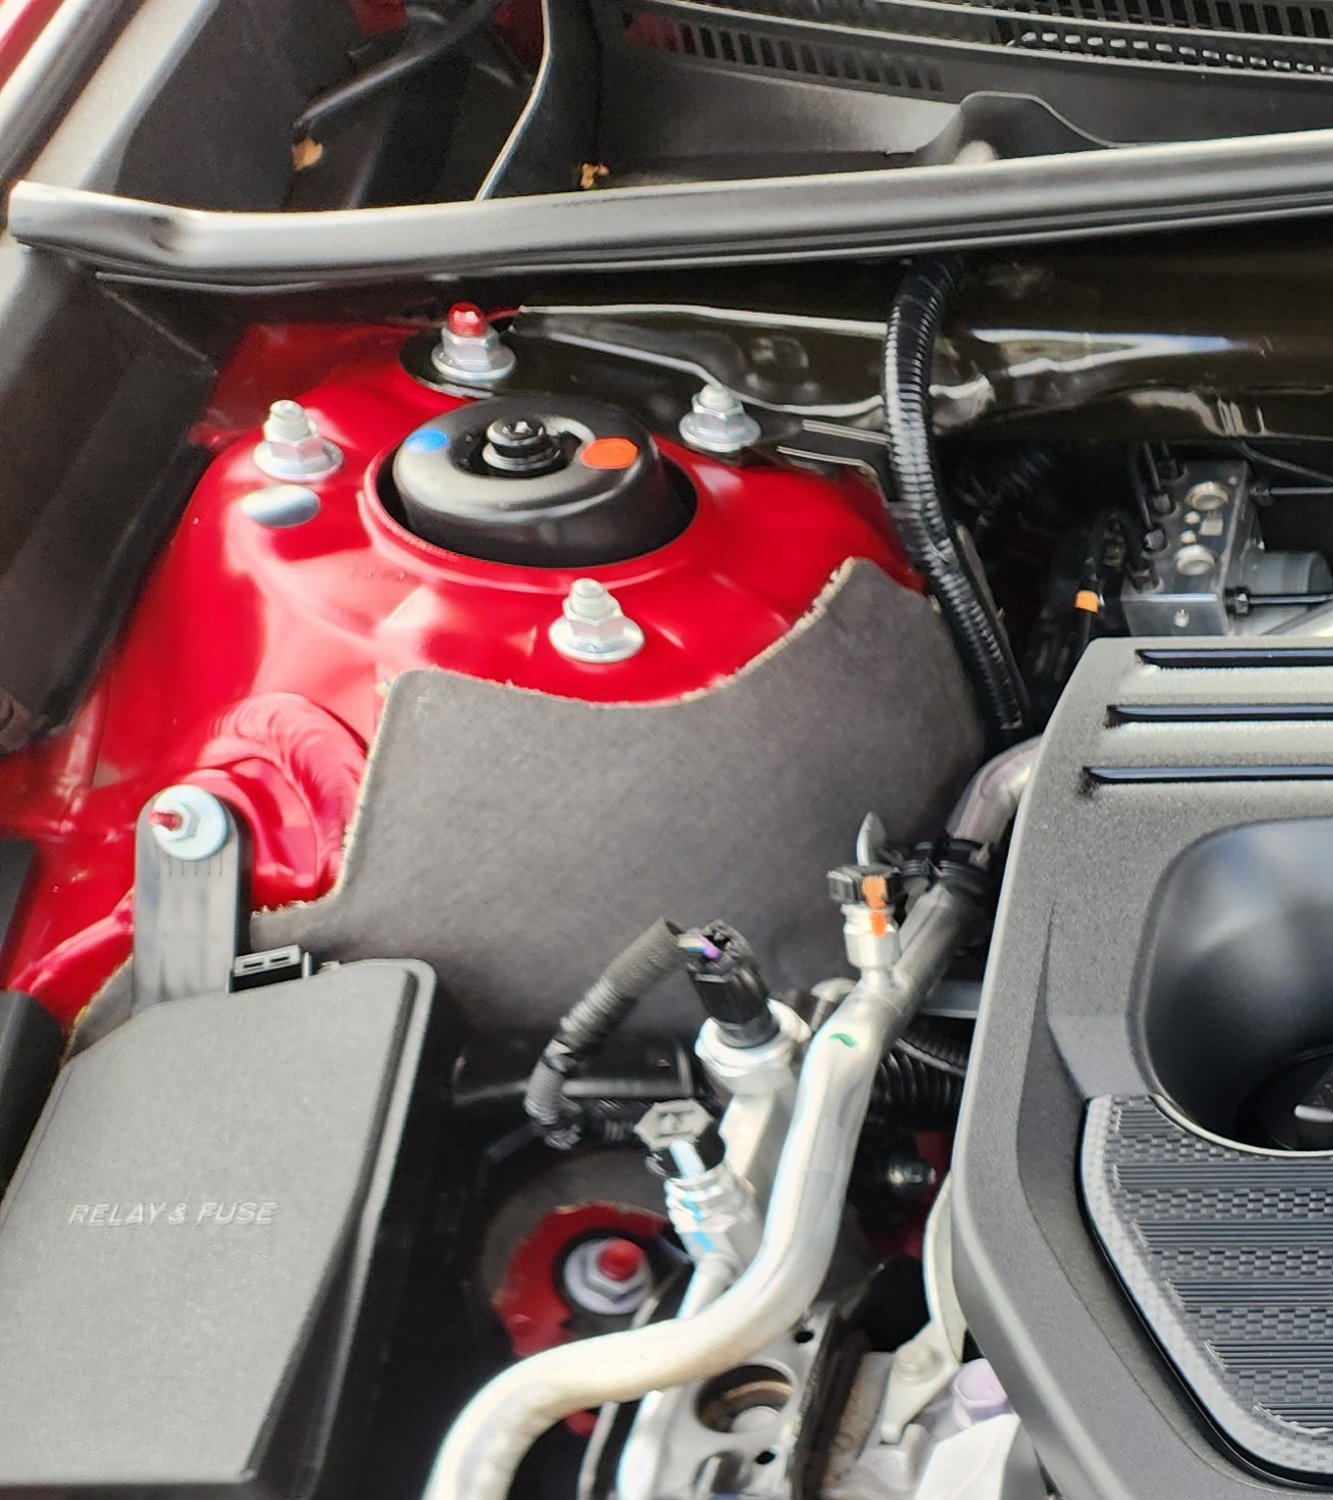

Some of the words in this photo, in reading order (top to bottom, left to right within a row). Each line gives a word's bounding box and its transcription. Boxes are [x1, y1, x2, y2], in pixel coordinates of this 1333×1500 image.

[68, 1202, 168, 1227] RELAY
[168, 1202, 187, 1225] &
[196, 1201, 280, 1226] FUSE
